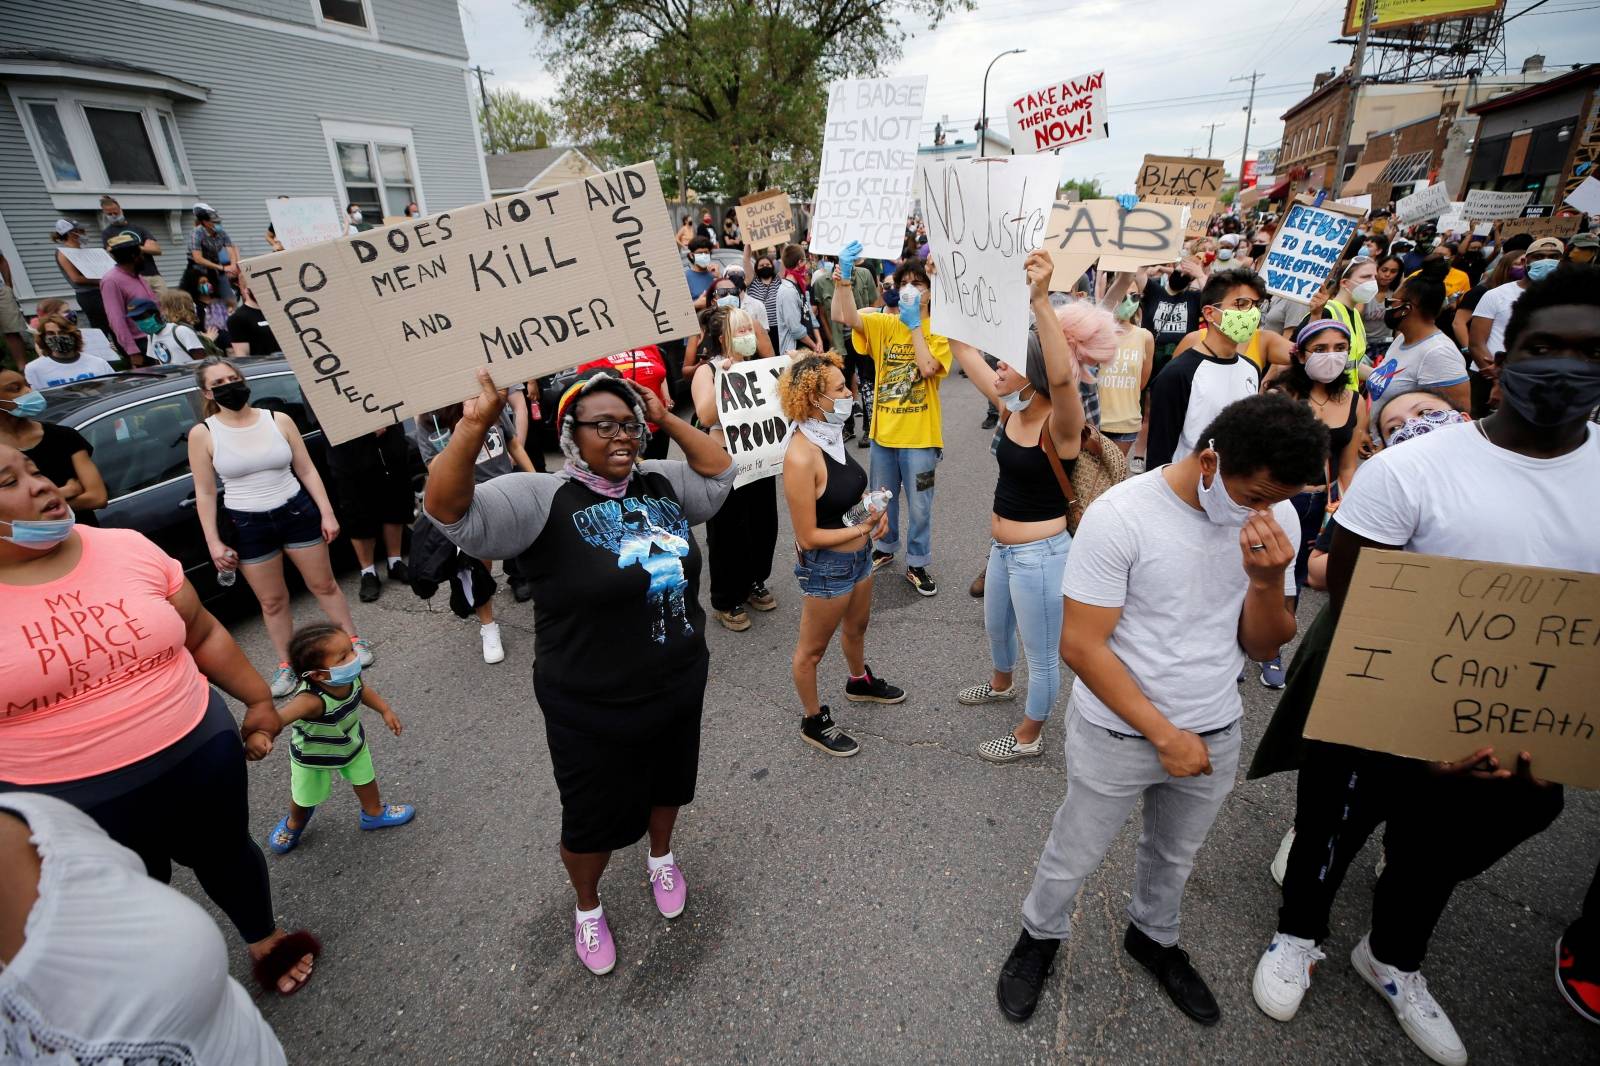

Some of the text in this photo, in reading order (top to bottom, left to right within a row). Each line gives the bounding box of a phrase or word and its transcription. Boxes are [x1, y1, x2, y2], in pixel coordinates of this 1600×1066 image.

[830, 82, 924, 113] A BADGE
[1013, 71, 1105, 114] TAKE AWAY
[827, 115, 923, 143] IS NOT
[1018, 95, 1093, 131] THEIR GUNS
[1034, 111, 1093, 149] NOW!
[824, 148, 915, 176] LICENSE
[1142, 165, 1220, 191] BLACK
[822, 179, 850, 198] TO
[922, 166, 966, 245] NO
[350, 213, 453, 263] DOES
[484, 191, 560, 231] NOT
[584, 170, 647, 212] AND
[746, 201, 776, 217] BLACK
[1283, 206, 1358, 245] REFUSE
[815, 221, 906, 250] POLICE
[1282, 234, 1343, 263] TO LOOK
[371, 255, 447, 297] MEAN
[1267, 252, 1331, 278] THE OTHER
[1267, 269, 1321, 299] WAY!
[401, 312, 452, 342] AND
[283, 297, 404, 424] PROTECT
[721, 371, 766, 413] ARE
[726, 416, 787, 454] PROUD
[572, 499, 623, 537] PINK
[44, 590, 83, 613] MY
[1369, 561, 1580, 606] I CAN'T
[21, 598, 130, 649] HAPPY
[1445, 611, 1516, 642] NO
[38, 618, 151, 675] PLACE
[69, 645, 138, 686] IS IN
[1346, 646, 1556, 691] I CAN'T
